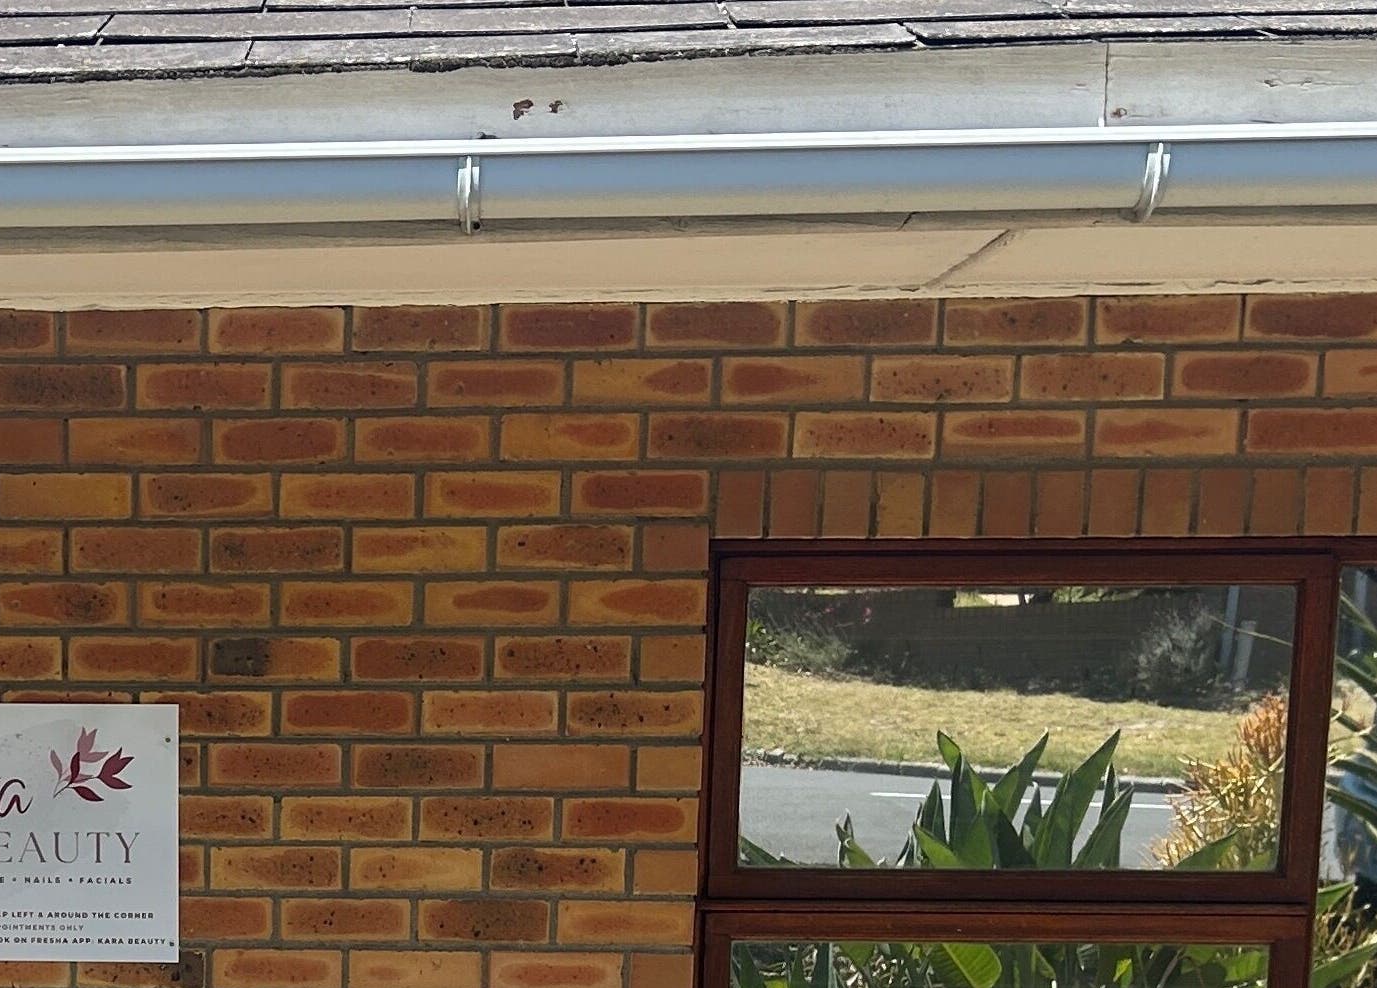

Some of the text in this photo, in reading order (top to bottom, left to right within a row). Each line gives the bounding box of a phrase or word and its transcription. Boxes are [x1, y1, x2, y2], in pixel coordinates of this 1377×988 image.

[24, 876, 62, 885] NAILS
[79, 877, 133, 885] FACIALS
[12, 911, 34, 919] LEFT
